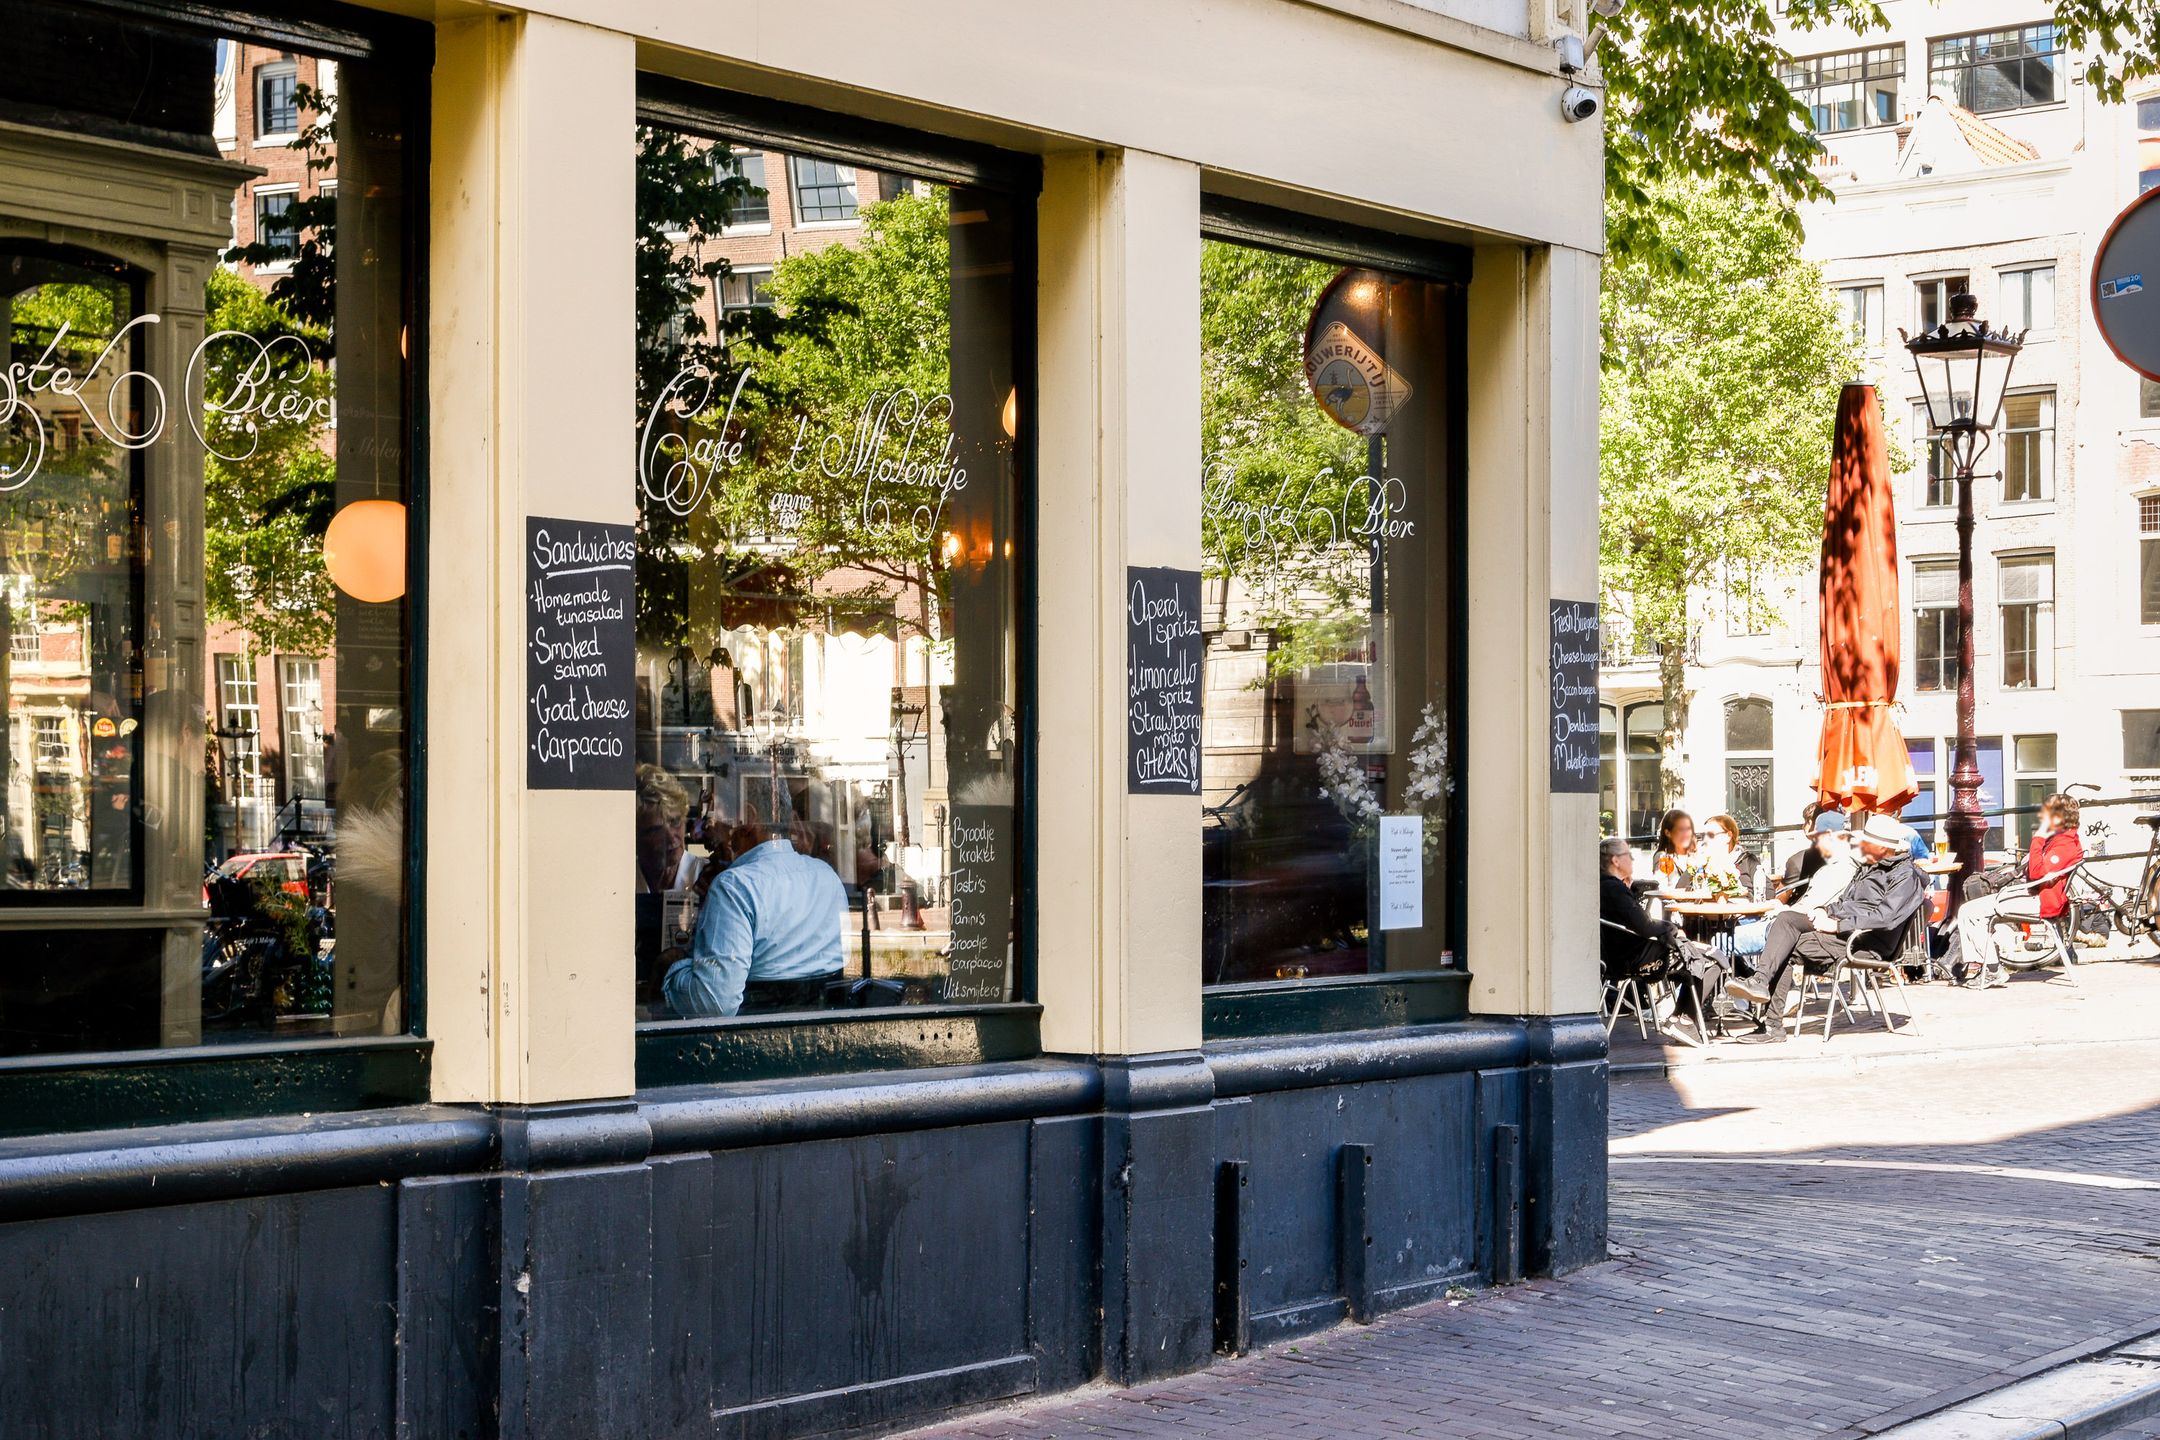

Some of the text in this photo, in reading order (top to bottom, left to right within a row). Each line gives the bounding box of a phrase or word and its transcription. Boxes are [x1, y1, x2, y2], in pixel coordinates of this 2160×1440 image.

[1306, 345, 1367, 377] OUWERIJ
[185, 330, 331, 461] Bier
[639, 364, 750, 516] Café
[820, 388, 968, 542] Molentje
[769, 493, 813, 511] anno
[1201, 453, 1415, 594] Amstel Bier
[533, 529, 635, 569] Sandwiches
[1131, 580, 1184, 645] Aperol
[535, 626, 602, 664] Smoked
[1156, 611, 1200, 658] spritz
[554, 662, 607, 680] salmon
[1130, 644, 1197, 698] Limoncello
[536, 684, 630, 724] Goat cheese
[1159, 686, 1193, 713] spritz
[1132, 701, 1201, 746] Strawberry
[1154, 731, 1185, 751] mojito
[537, 728, 623, 773] Carpaccio
[951, 816, 995, 853] Broodje
[959, 845, 996, 863] kroket
[950, 867, 987, 894] Tosti's
[950, 898, 986, 926] Panini's
[949, 930, 988, 957] Broodje
[951, 957, 1003, 975] carpaccio
[943, 976, 1000, 1001] Uitsmijters
